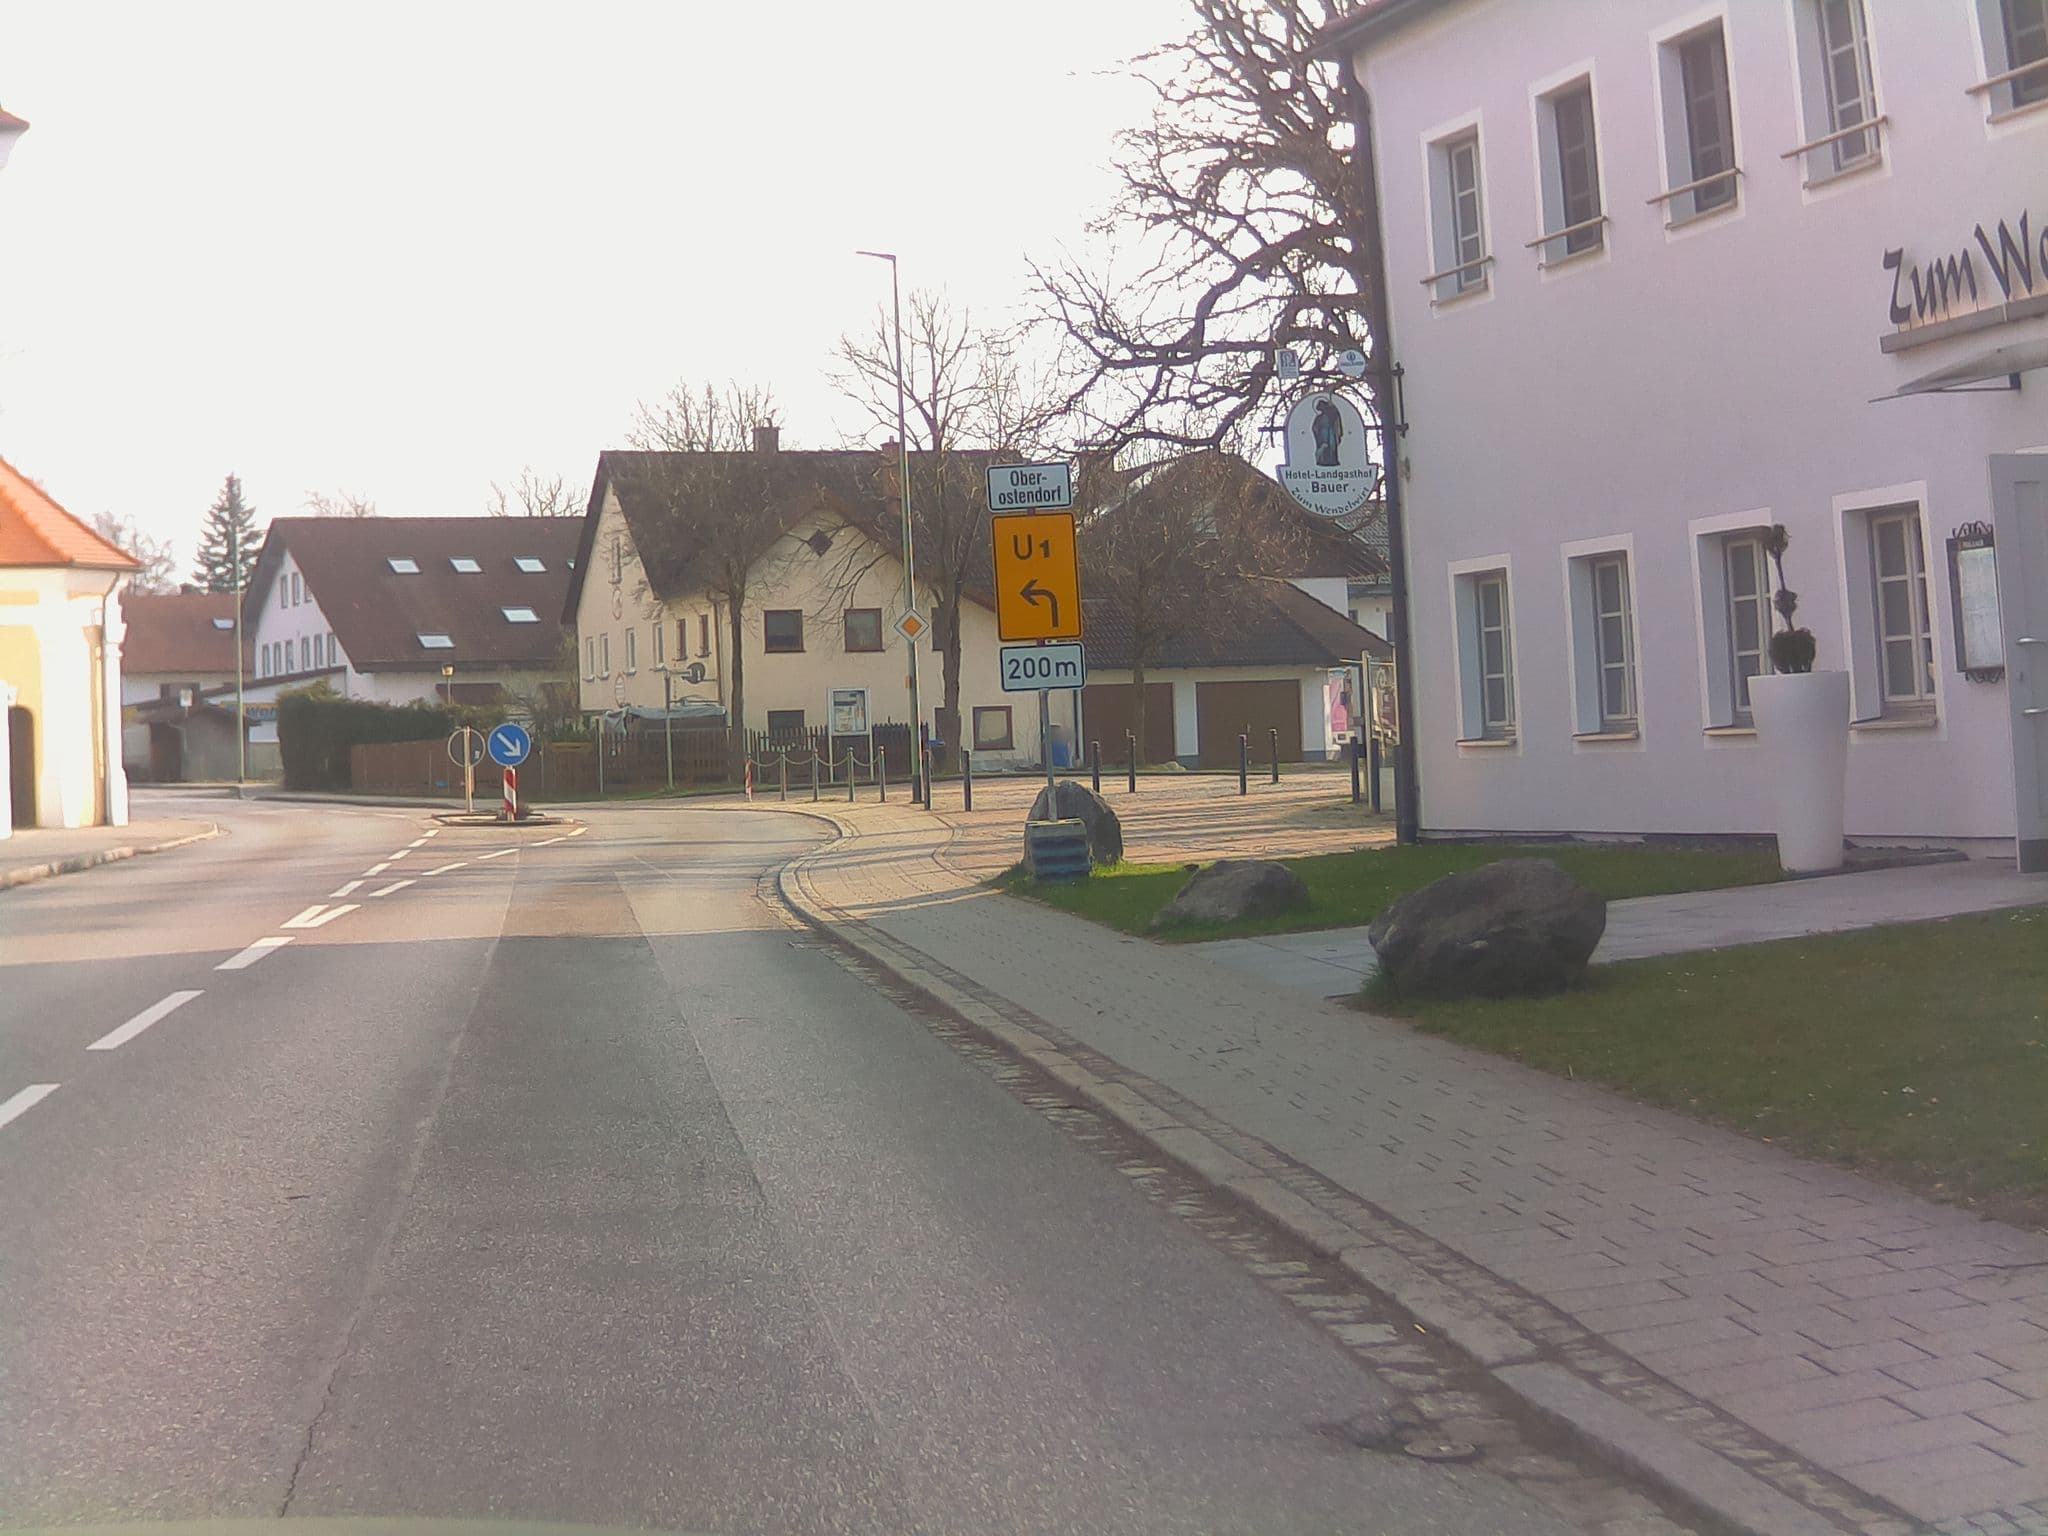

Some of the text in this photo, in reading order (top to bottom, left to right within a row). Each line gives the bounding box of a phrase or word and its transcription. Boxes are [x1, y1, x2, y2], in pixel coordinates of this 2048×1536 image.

[1883, 247, 1978, 324] Zum
[1010, 470, 1048, 487] Ober-
[1285, 469, 1372, 480] Hotel-Landgasthof
[998, 485, 1061, 505] ostendorf
[1311, 481, 1349, 493] Bauer
